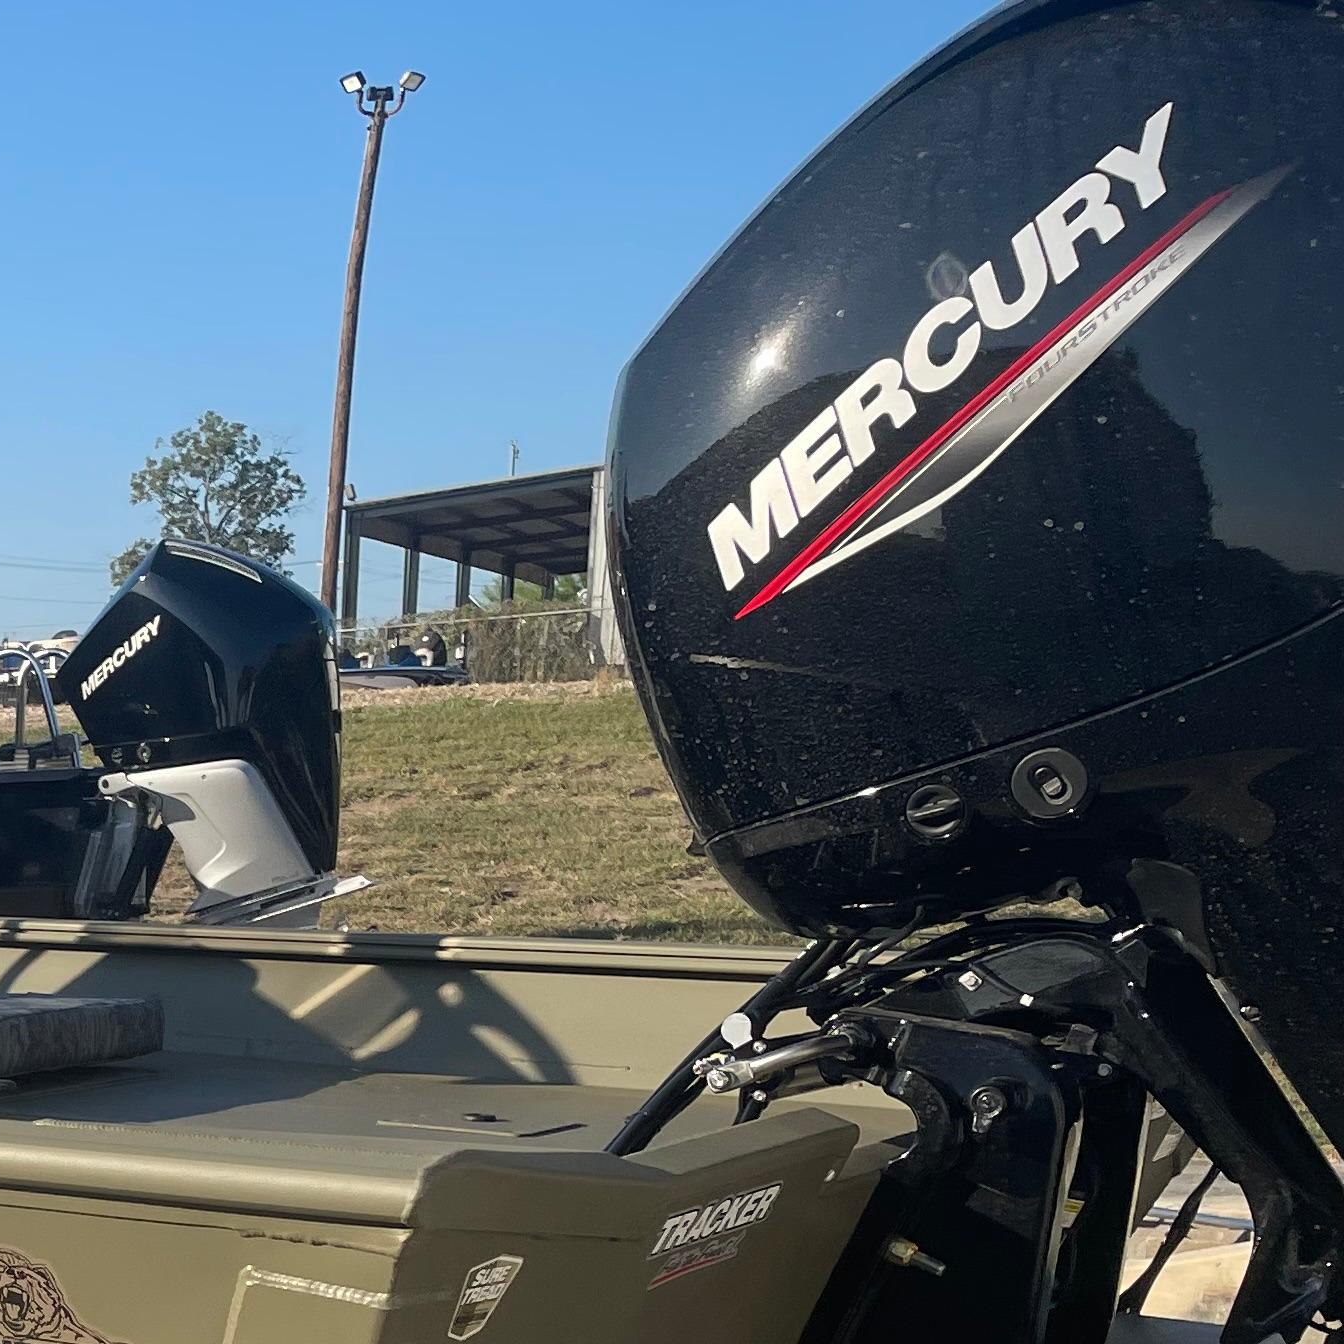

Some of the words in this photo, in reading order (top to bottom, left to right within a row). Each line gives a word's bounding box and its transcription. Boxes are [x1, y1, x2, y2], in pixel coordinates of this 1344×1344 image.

[707, 102, 1174, 592] MERCURY
[1005, 243, 1188, 402] FOURSTROKE
[81, 615, 161, 700] MERCURY
[650, 1183, 783, 1257] TRACKER
[461, 1282, 510, 1305] TREAD
[471, 1265, 513, 1287] SURE
